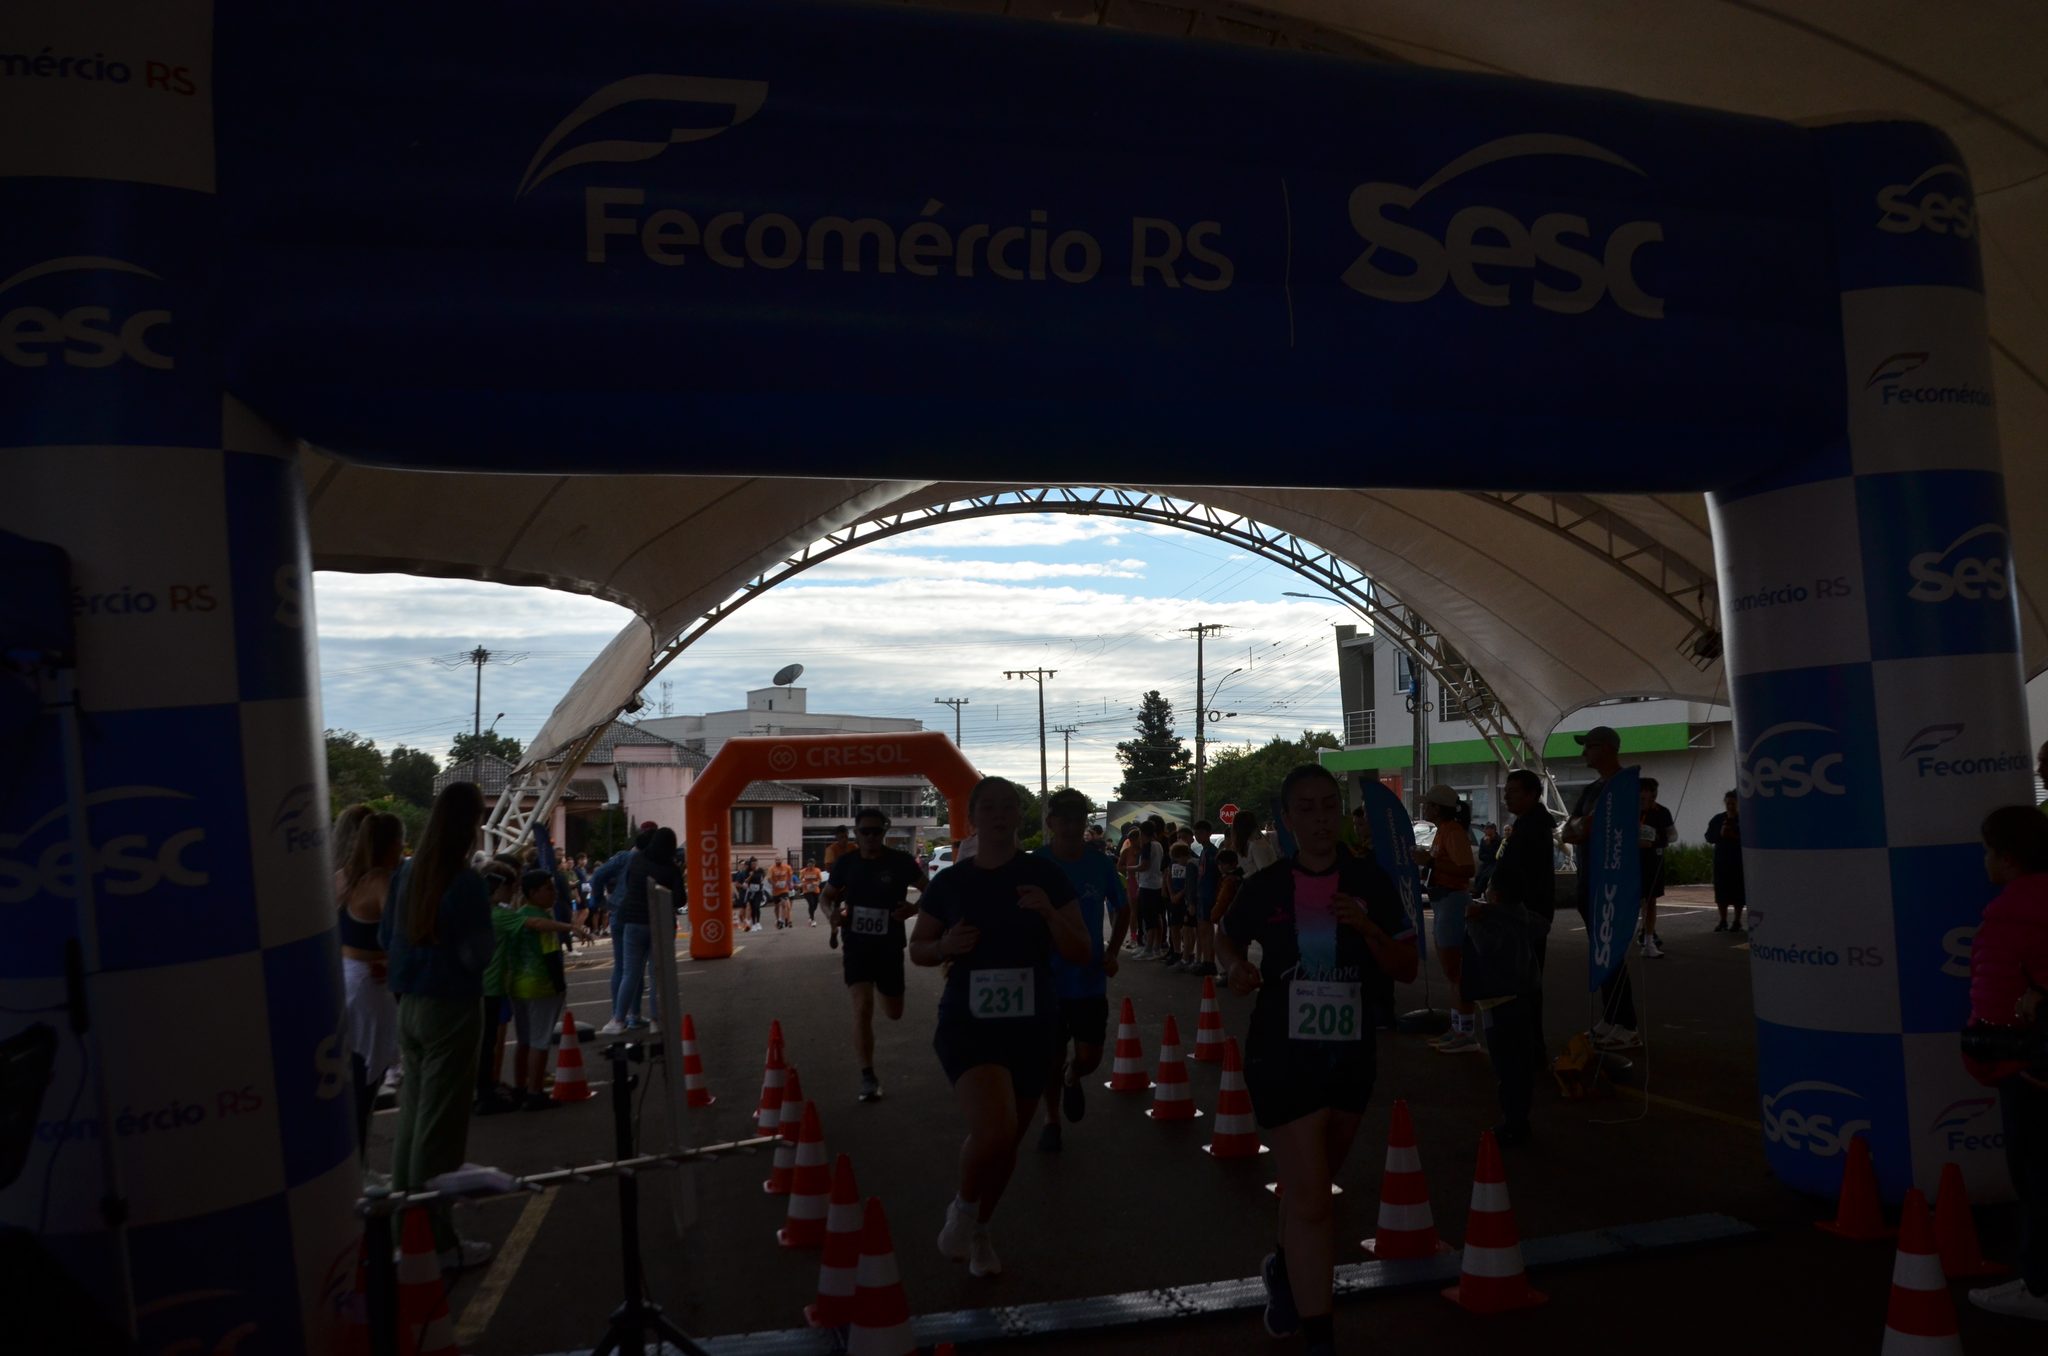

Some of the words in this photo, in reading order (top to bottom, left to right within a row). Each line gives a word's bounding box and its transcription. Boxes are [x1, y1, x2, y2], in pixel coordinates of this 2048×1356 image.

[145, 60, 196, 96] RS
[1876, 163, 1974, 239] Ses
[585, 185, 1102, 284] Fecomércio
[1129, 216, 1235, 292] RS
[1340, 133, 1665, 319] Sesc
[0, 255, 175, 370] esc
[1907, 523, 2009, 603] Ses
[71, 585, 157, 616] ércio
[168, 584, 218, 612] RS
[1815, 576, 1850, 600] RS
[805, 744, 911, 768] CRESOL
[701, 823, 720, 912] CRESOL
[856, 917, 883, 932] 506
[1593, 883, 1619, 969] Sesc
[1848, 947, 1884, 967] RS
[978, 986, 1024, 1013] 231
[1298, 1003, 1354, 1035] 208
[217, 1086, 262, 1118] RS
